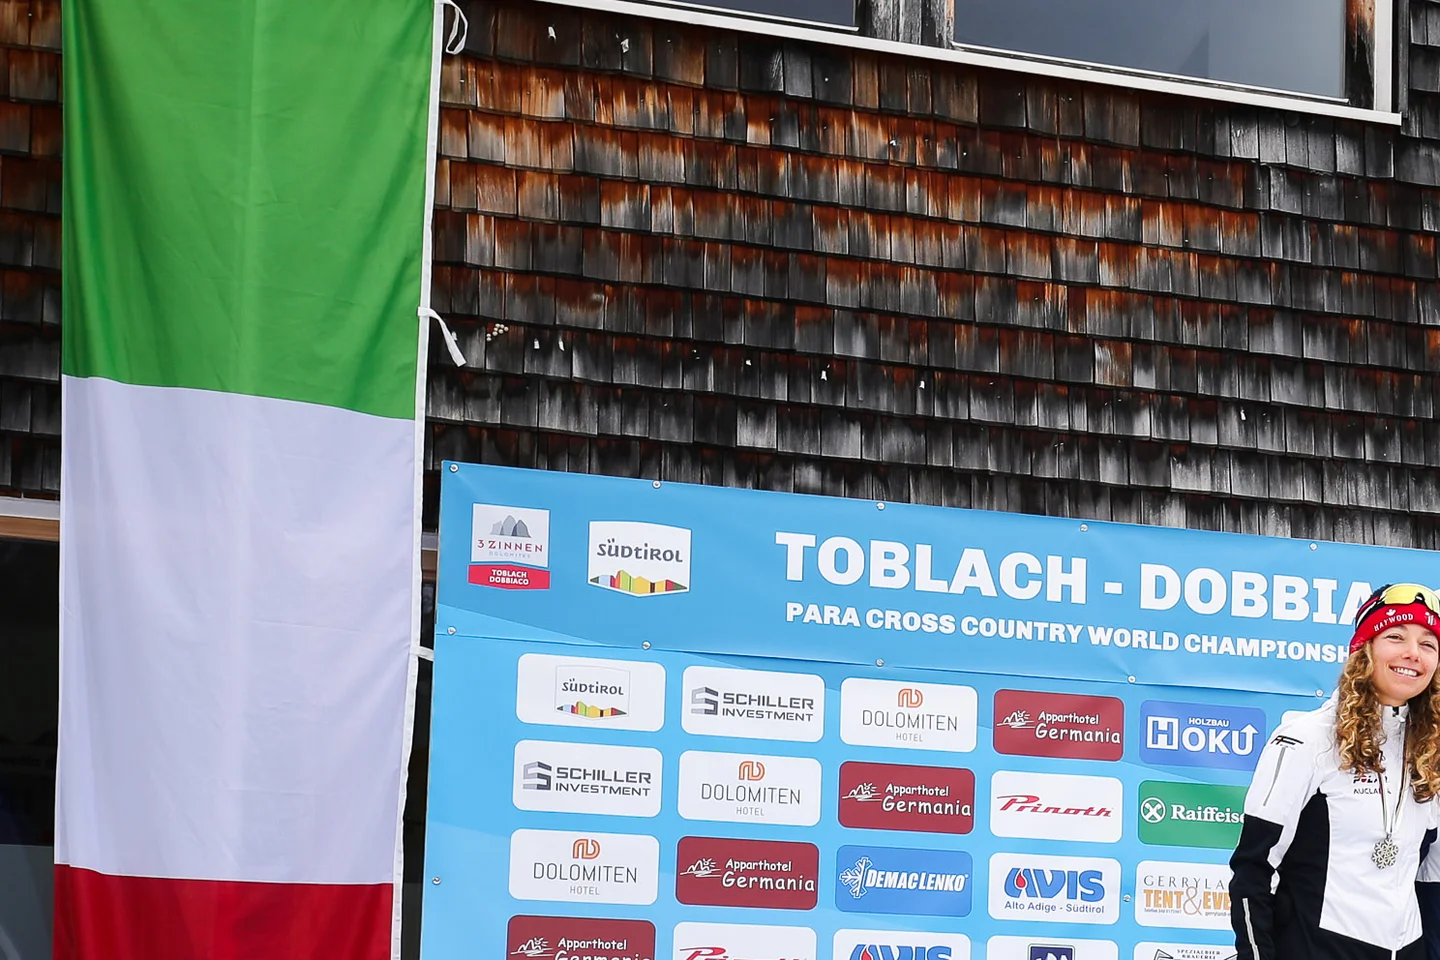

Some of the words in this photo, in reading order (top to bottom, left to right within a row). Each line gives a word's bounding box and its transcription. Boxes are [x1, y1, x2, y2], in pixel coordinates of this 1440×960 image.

[477, 539, 485, 549] 3
[488, 540, 543, 552] ZINNEN
[491, 569, 527, 578] TOBLACH
[775, 531, 1088, 605] TOBLACH
[489, 576, 529, 585] DOBBIACO
[786, 602, 861, 628] PARA
[865, 608, 956, 635] CROSS
[960, 615, 1084, 644] COUNTRY
[1087, 626, 1180, 651] WORLD
[1373, 612, 1414, 632] HAYWOOD
[723, 692, 814, 710] SCHILLER
[722, 708, 814, 722] INVESTMENT
[862, 709, 958, 732] DOLOMITEN
[1038, 710, 1099, 725] Apparthotel
[1188, 717, 1229, 727] HOLZBAU
[896, 732, 923, 742] HOTEL
[1035, 723, 1121, 744] Germania
[1146, 716, 1259, 756] HOKU
[556, 766, 651, 784] SCHILLER
[555, 782, 650, 797] INVESTMENT
[702, 783, 801, 805] DOLOMITEN
[885, 782, 949, 797] Apparthotel
[736, 806, 765, 816] HOTEL
[882, 796, 972, 817] Germania
[996, 794, 1112, 818] Prinoth
[1170, 804, 1245, 824] Raiffeise
[533, 862, 638, 884] DOLOMITEN
[725, 858, 792, 873] Apparthotel
[569, 885, 600, 896] HOTEL
[722, 871, 815, 893] Germania
[1004, 867, 1106, 903] AVIS
[1143, 875, 1225, 890] GERRYLA
[1004, 900, 1025, 911] Alto
[1028, 901, 1056, 914] Adige
[1066, 902, 1105, 914] Südtirol
[1144, 889, 1184, 909] TENT
[1183, 886, 1203, 916] &
[557, 937, 627, 951] Apparthotel
